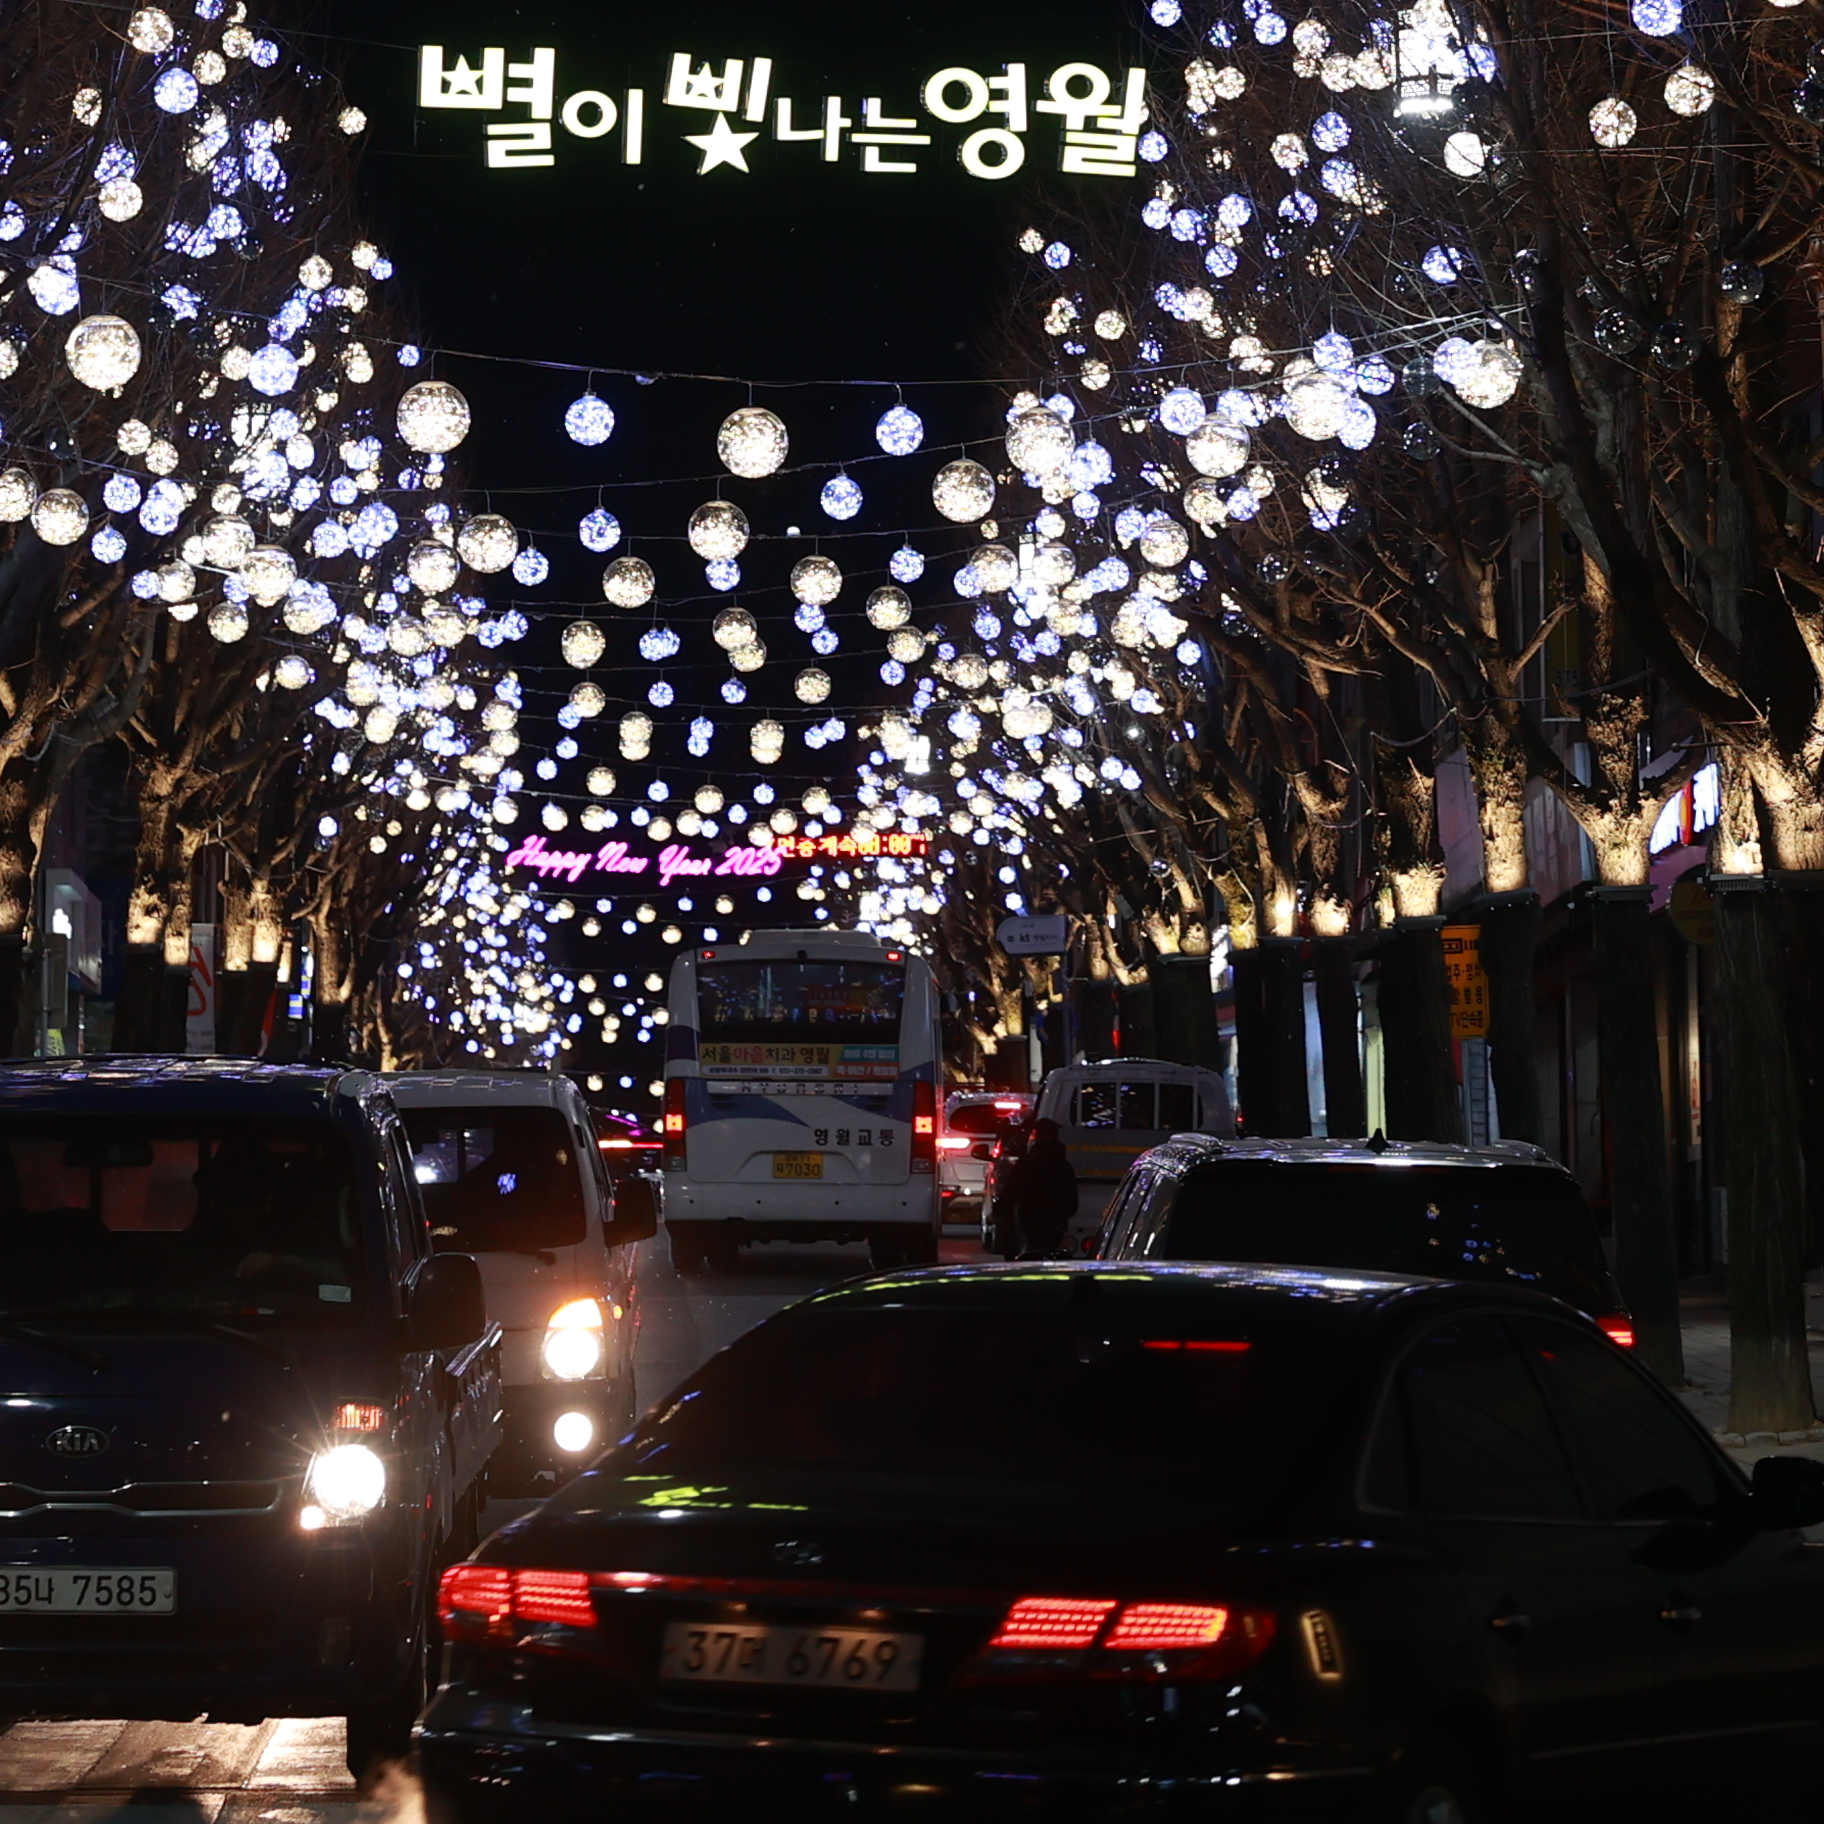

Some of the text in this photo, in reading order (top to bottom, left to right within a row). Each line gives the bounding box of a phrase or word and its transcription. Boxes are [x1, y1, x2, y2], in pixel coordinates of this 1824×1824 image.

[417, 45, 642, 169] 별이
[920, 62, 1148, 180] 영월
[506, 834, 785, 886] Happy New Year 2025
[702, 1045, 795, 1064] 서울마음치과
[814, 1128, 895, 1147] 영월교통
[56, 1432, 100, 1451] KIA
[72, 1575, 157, 1606] 7585
[785, 1634, 899, 1682] 6769
